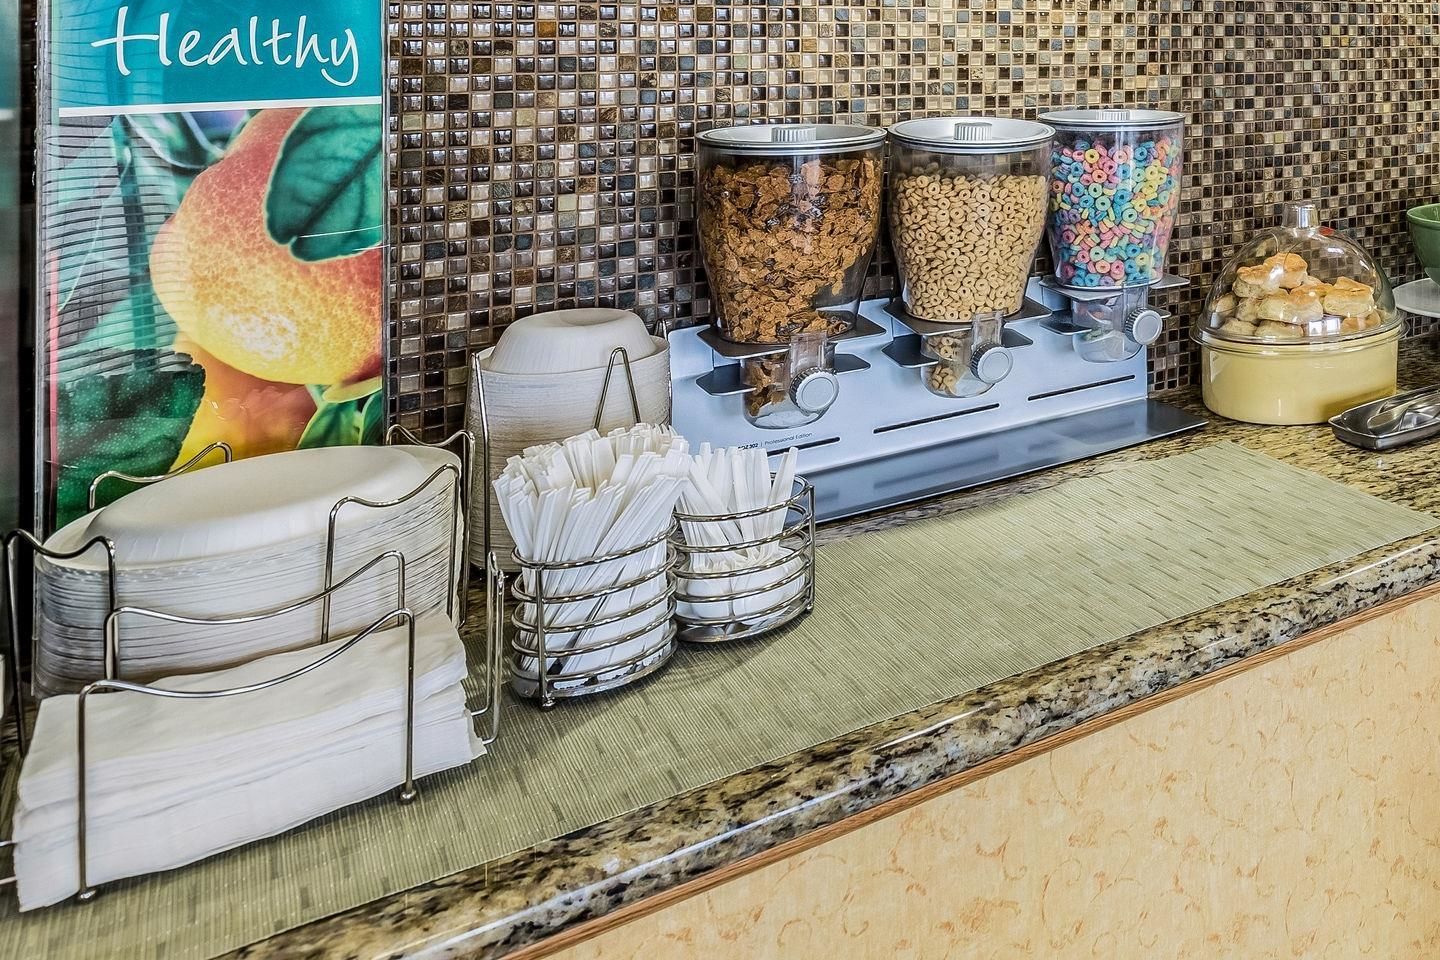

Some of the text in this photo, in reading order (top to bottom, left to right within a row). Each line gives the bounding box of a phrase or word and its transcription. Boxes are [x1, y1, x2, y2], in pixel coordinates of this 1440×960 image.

[91, 5, 359, 87] Healthy
[764, 435, 795, 446] Professional
[795, 432, 813, 440] Edition
